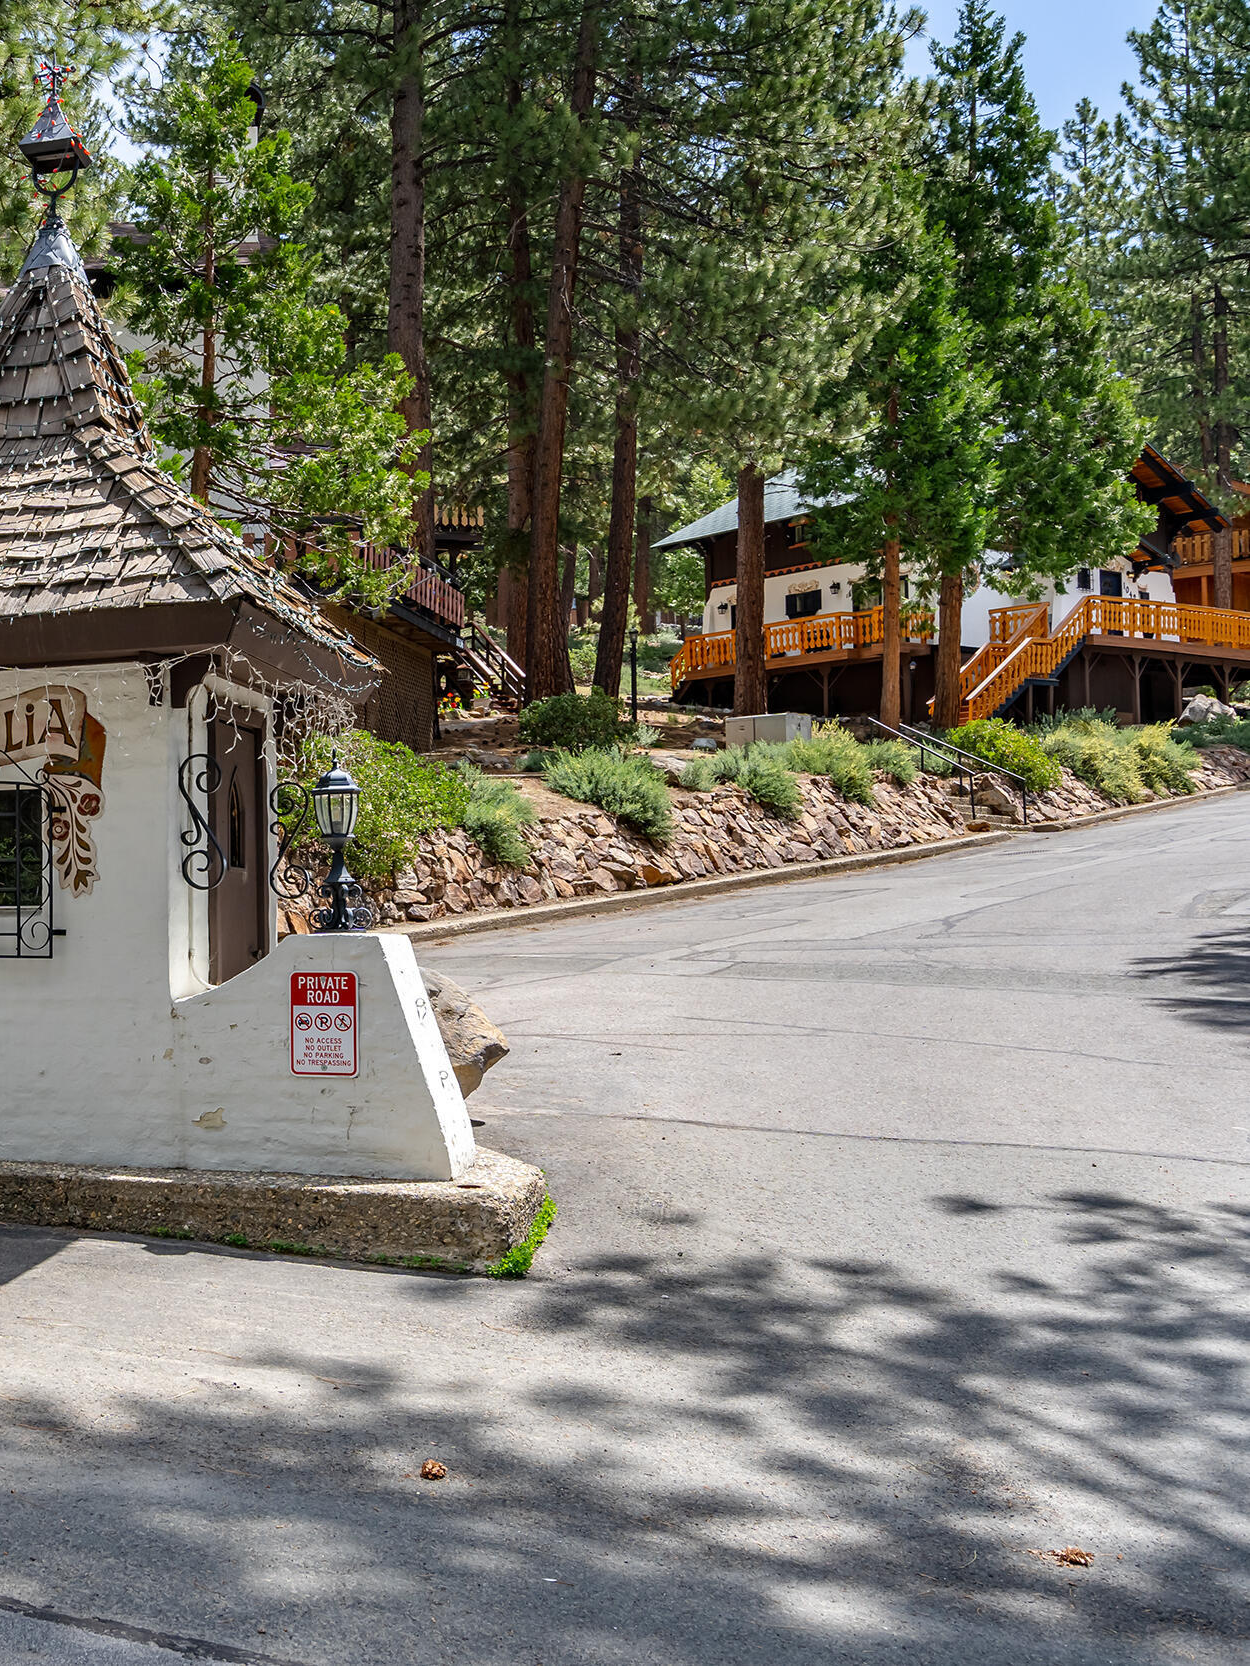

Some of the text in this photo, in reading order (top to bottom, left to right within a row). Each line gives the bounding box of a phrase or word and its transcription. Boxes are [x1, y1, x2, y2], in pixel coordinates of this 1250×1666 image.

[298, 976, 349, 990] PRIVATE
[307, 990, 340, 1004] ROAD
[308, 1059, 351, 1067] TRESPASSING
